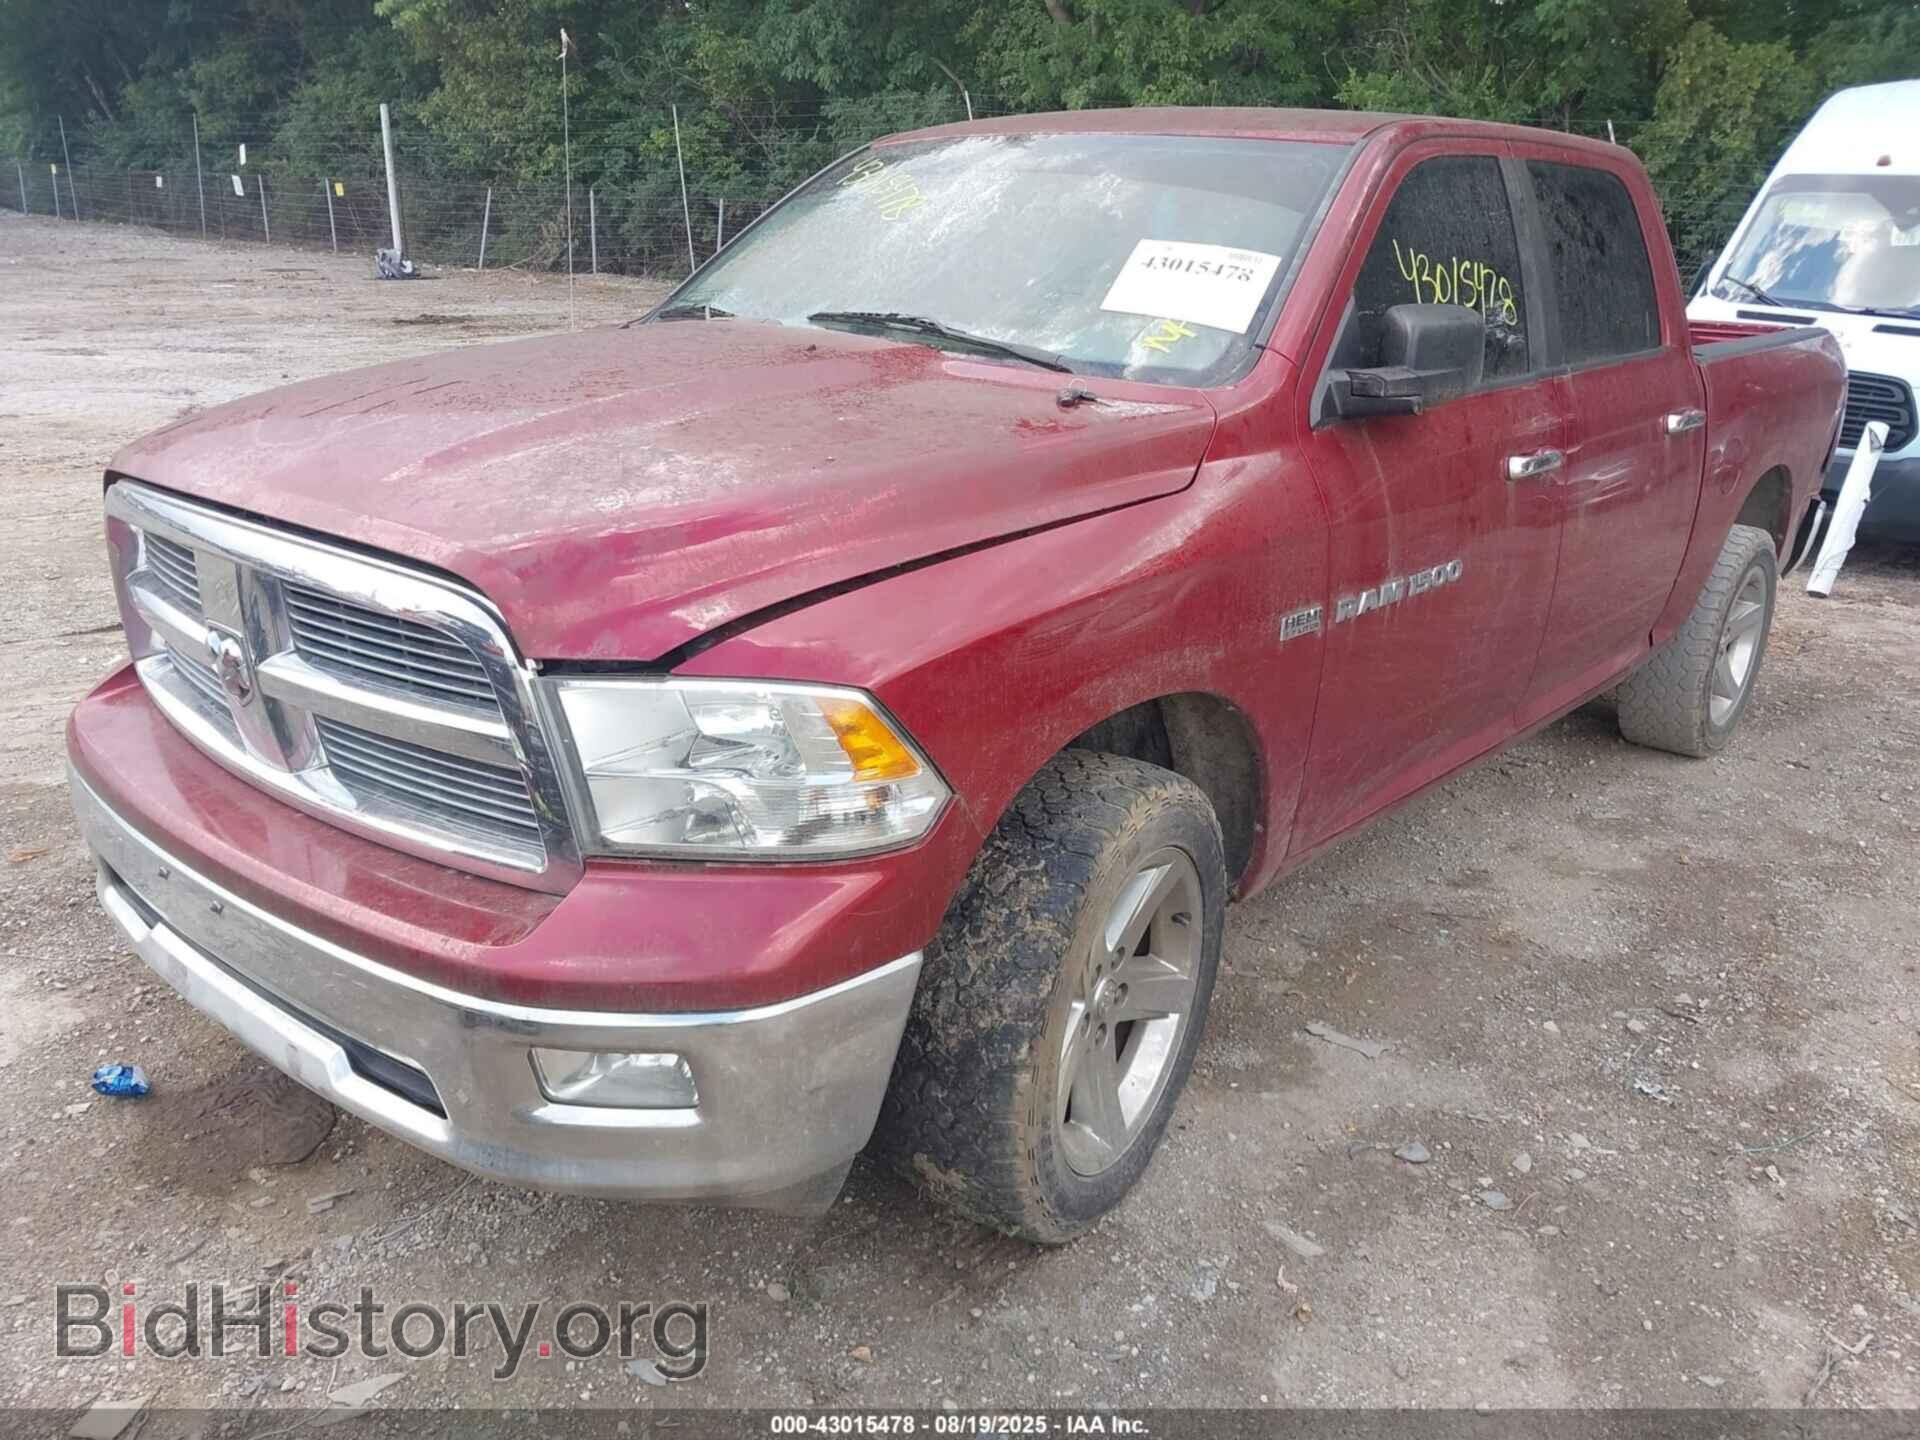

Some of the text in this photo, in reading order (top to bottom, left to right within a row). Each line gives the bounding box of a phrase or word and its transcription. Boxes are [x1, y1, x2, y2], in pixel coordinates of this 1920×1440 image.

[1140, 256, 1254, 282] 43015478
[1392, 238, 1517, 326] 43015478
[1335, 560, 1463, 623] RAM 1500
